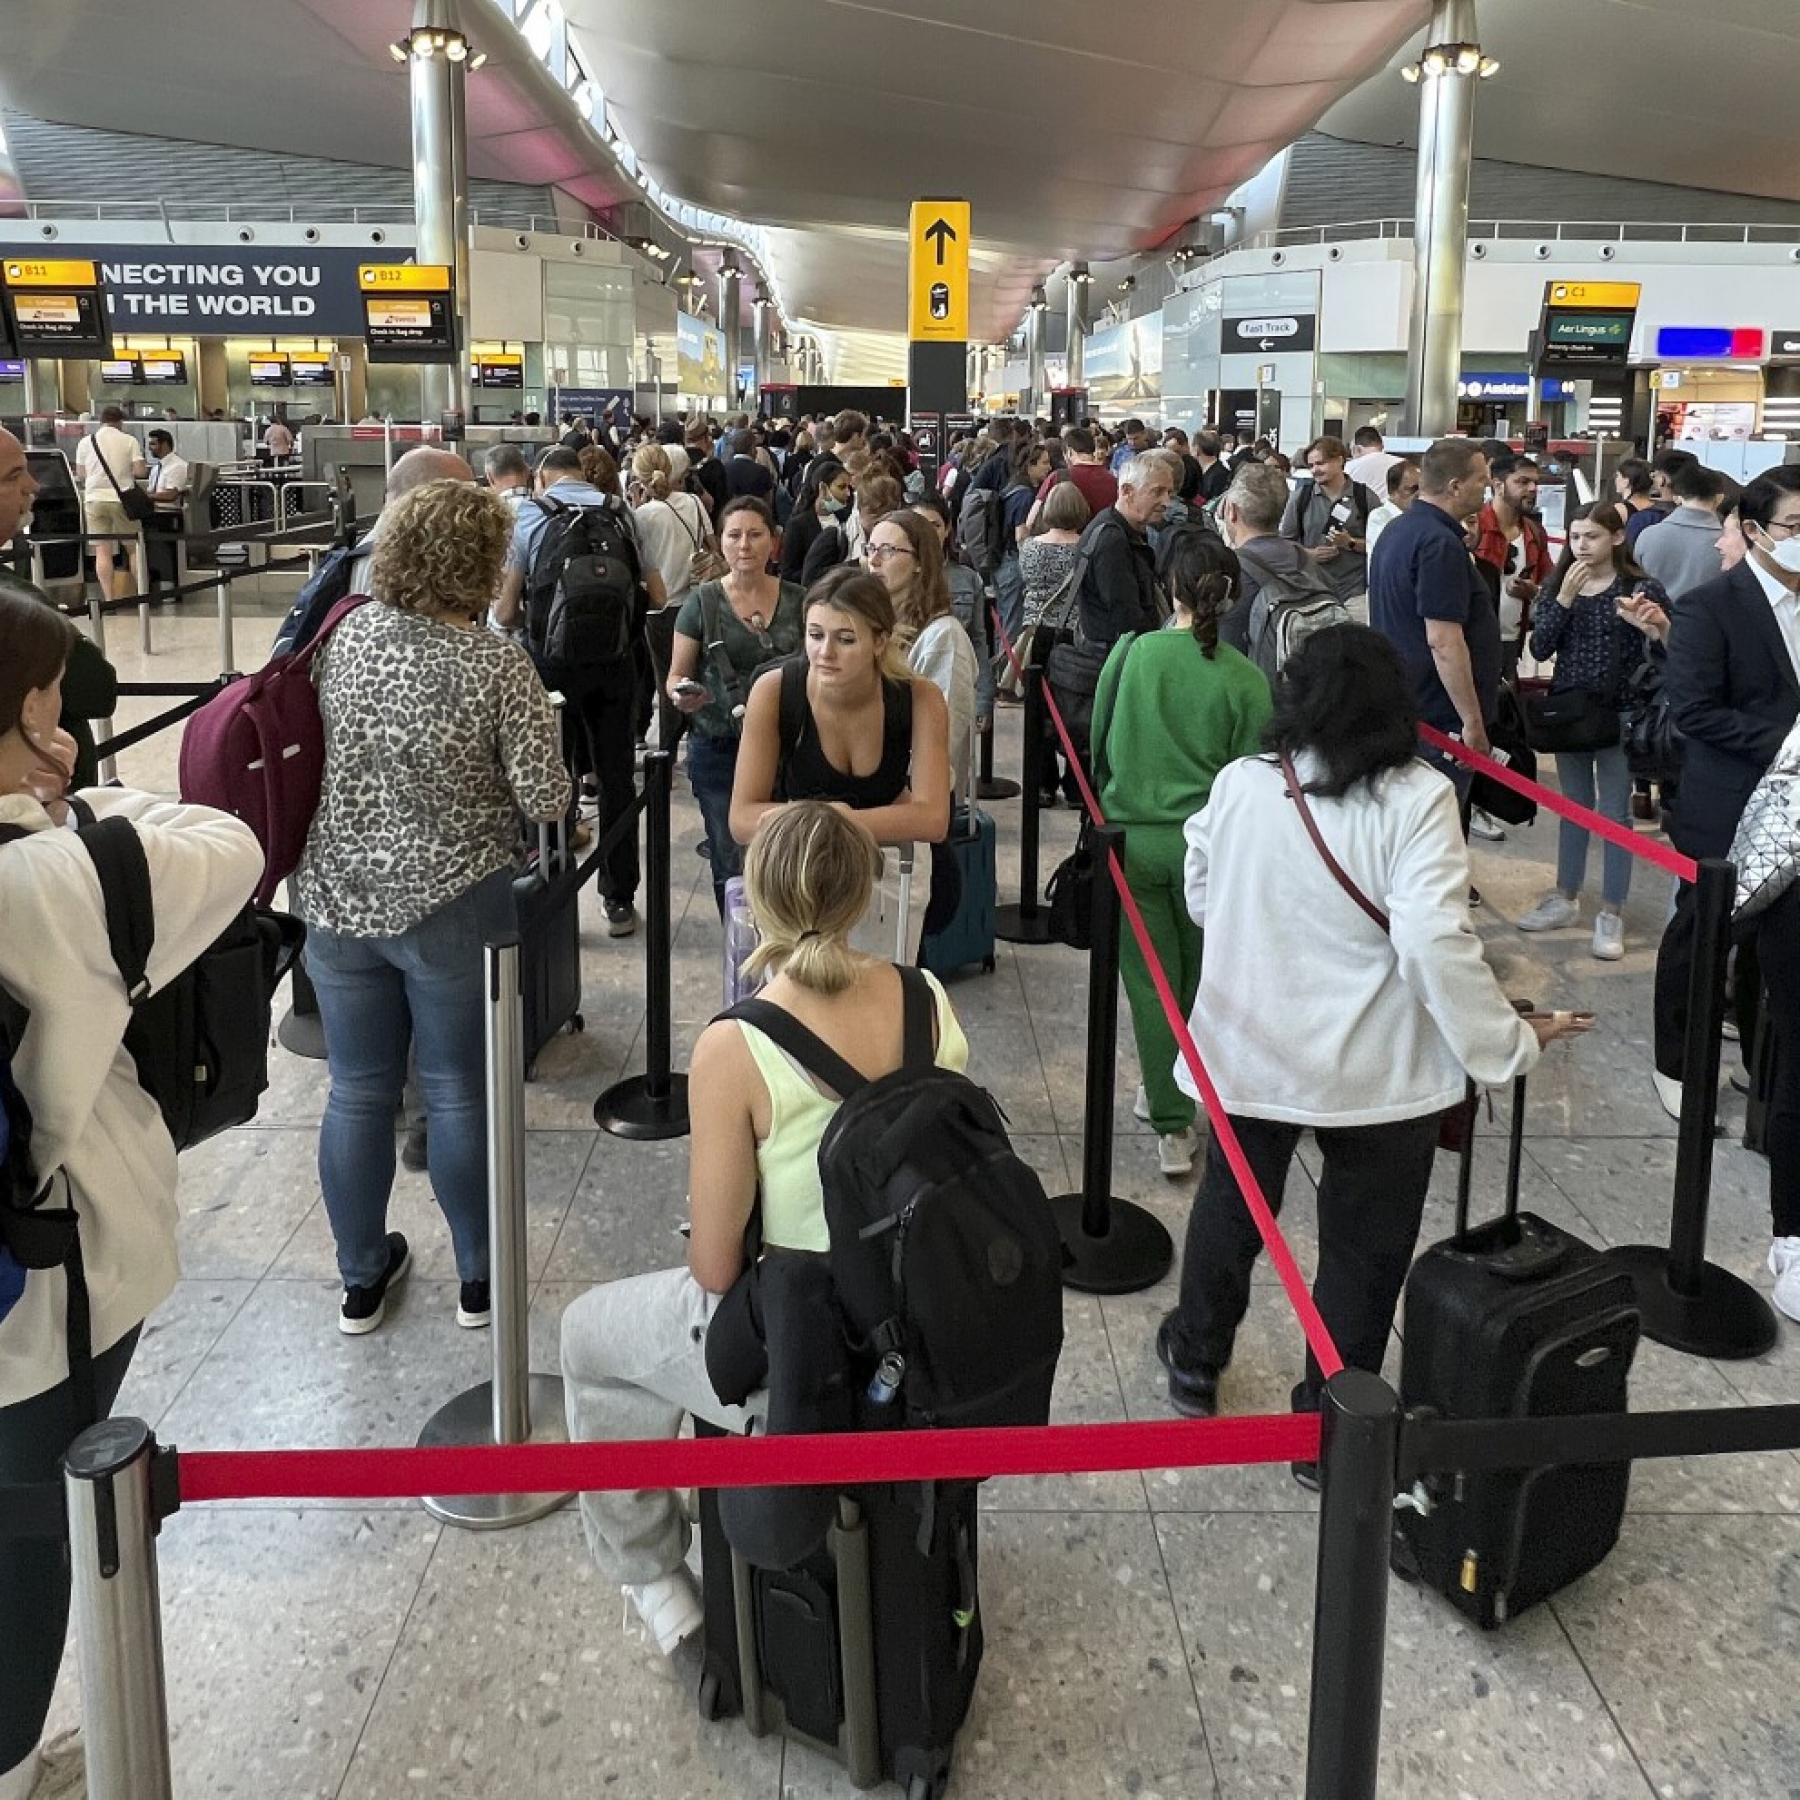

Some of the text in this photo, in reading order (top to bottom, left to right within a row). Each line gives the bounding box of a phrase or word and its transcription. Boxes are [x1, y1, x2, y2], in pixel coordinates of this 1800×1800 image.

[25, 264, 47, 276] B11
[379, 270, 402, 281] B12
[252, 265, 321, 287] YOU
[1571, 286, 1585, 297] C1
[123, 294, 189, 315] THE
[196, 295, 316, 316] WORLD
[1244, 322, 1290, 333] Fast Track
[1558, 325, 1607, 336] Aer Lingus
